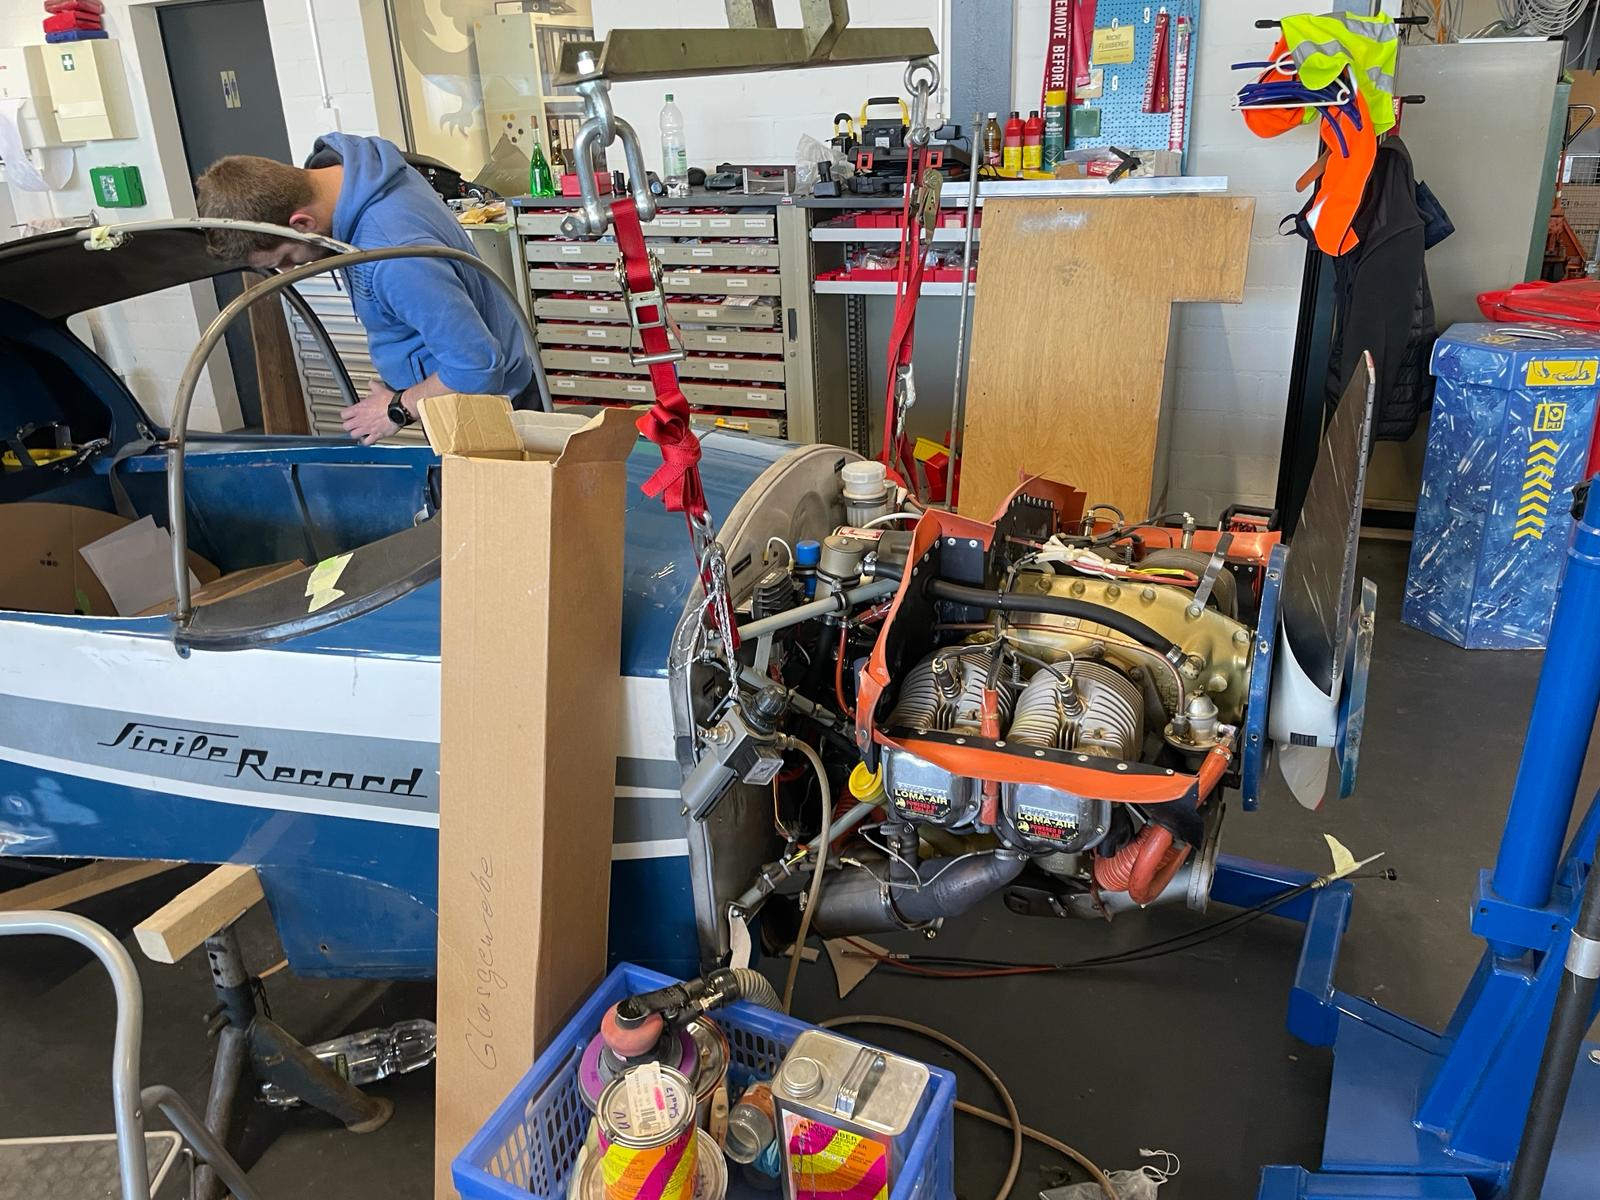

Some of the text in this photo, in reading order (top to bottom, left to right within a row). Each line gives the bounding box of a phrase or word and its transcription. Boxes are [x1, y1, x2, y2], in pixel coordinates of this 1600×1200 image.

[1051, 45, 1065, 88] BEFORE
[894, 789, 948, 806] LOMA-AIR
[1018, 812, 1076, 830] LOMA-AIR
[465, 856, 508, 1071] Glasgewebe
